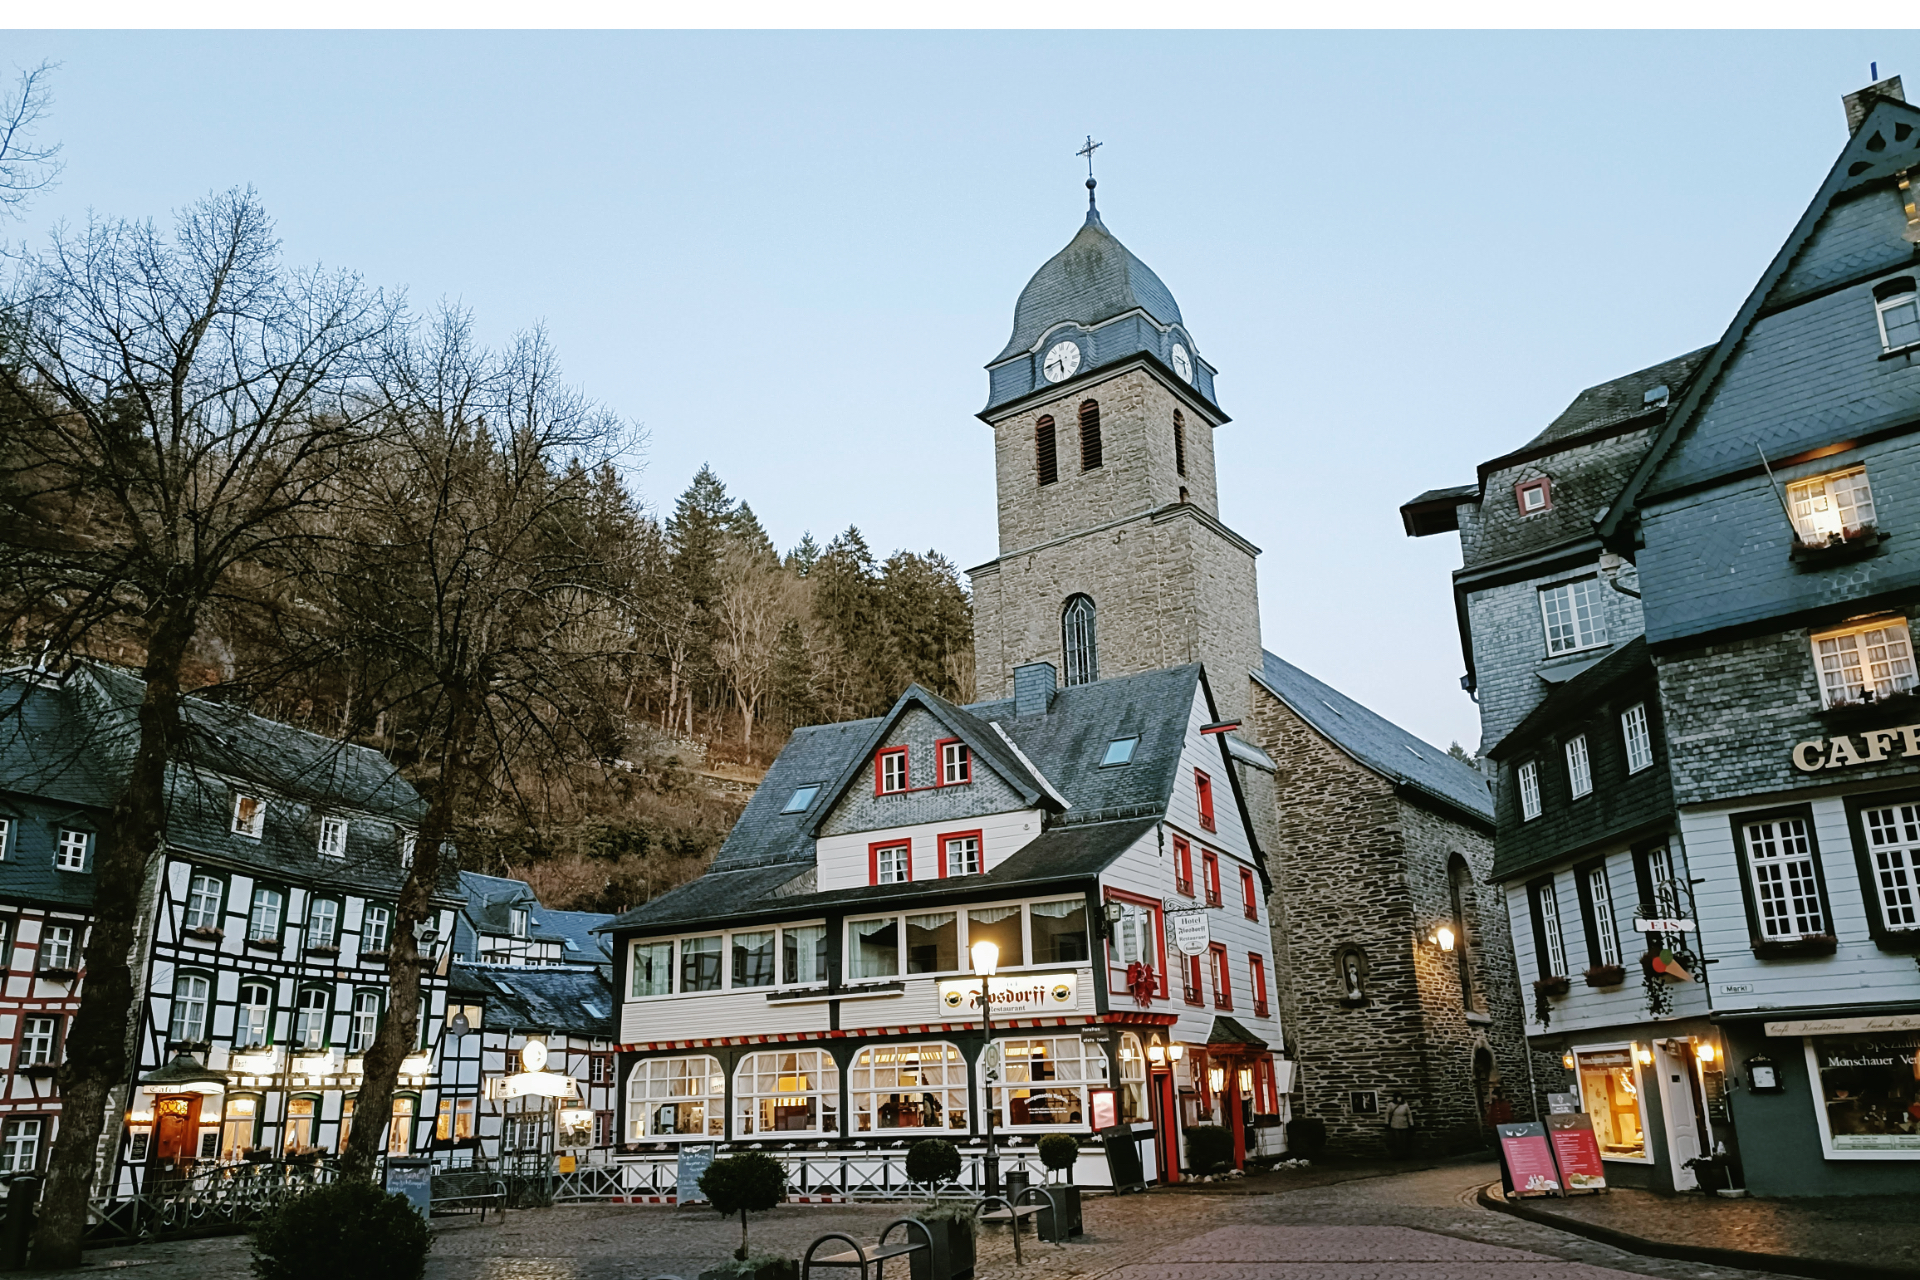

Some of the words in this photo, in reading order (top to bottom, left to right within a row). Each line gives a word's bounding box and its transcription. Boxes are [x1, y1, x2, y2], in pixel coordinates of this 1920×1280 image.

[1651, 921, 1680, 930] EIS
[968, 985, 1045, 1010] Fosdorff
[1799, 1022, 1846, 1031] Konditorei
[1861, 1018, 1894, 1029] Lunch
[1828, 1055, 1894, 1067] Monschauer
